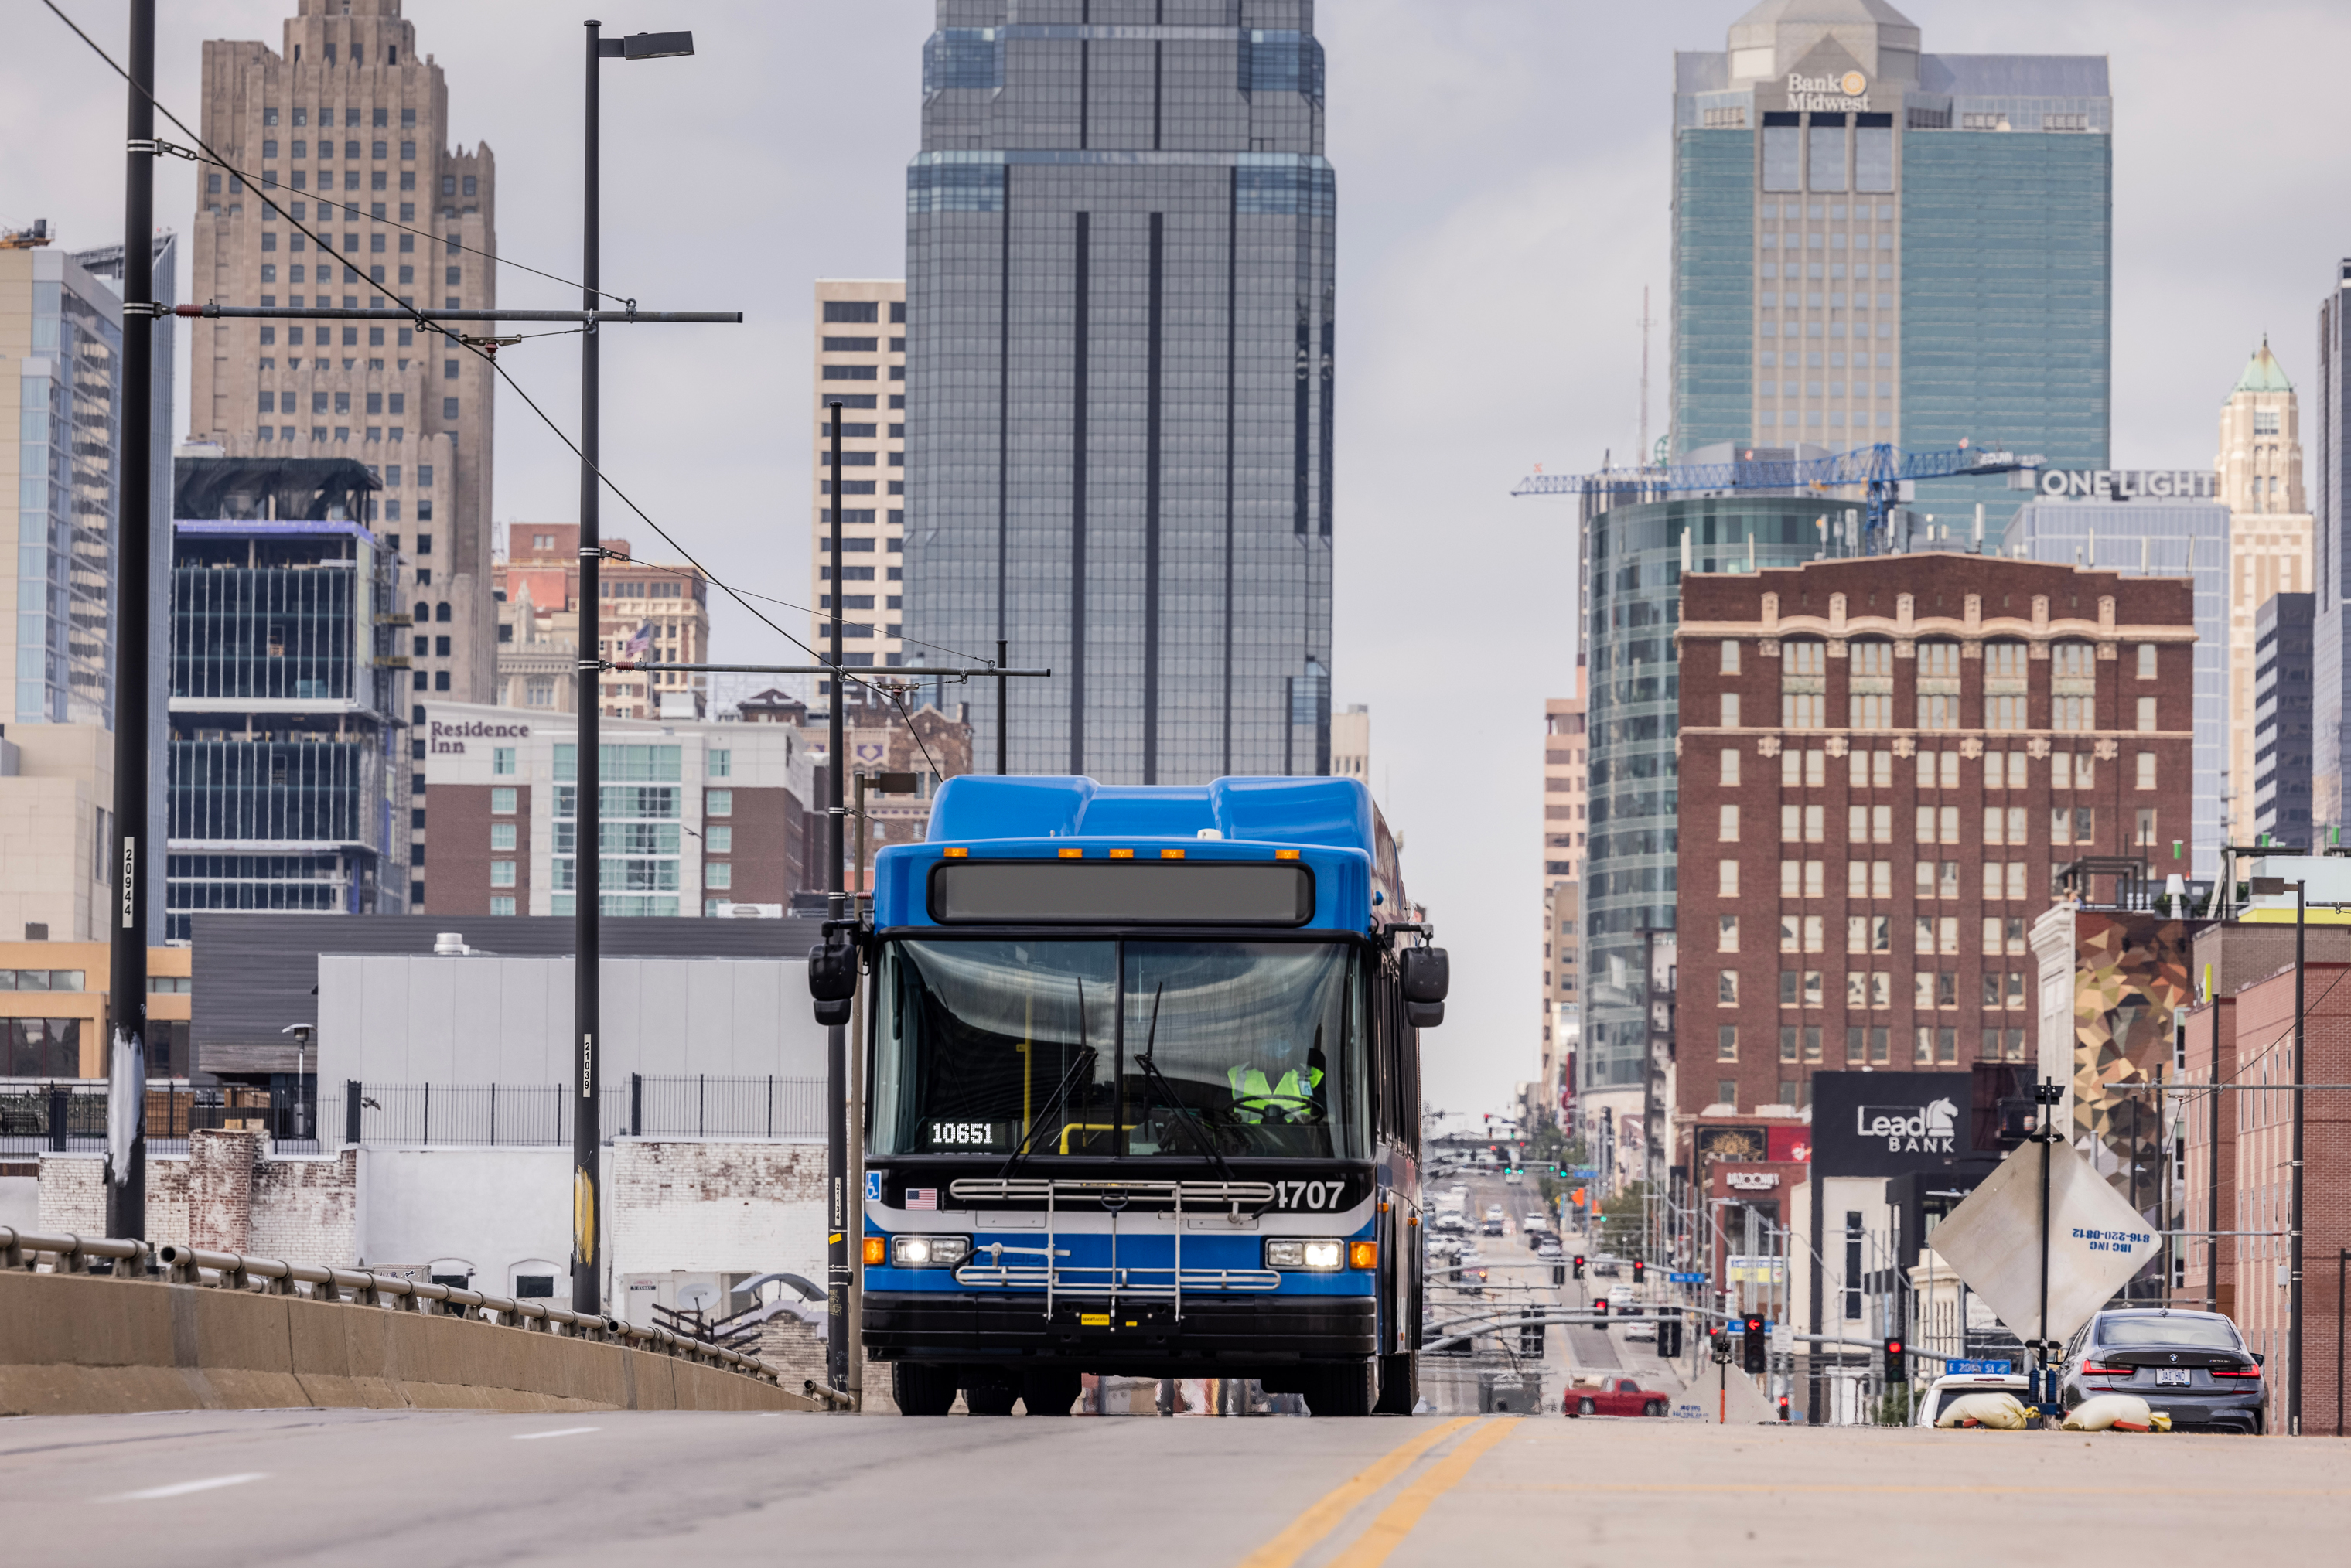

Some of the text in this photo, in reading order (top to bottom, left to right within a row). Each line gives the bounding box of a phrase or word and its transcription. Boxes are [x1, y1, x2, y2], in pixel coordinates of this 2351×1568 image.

[1787, 73, 1841, 92] Bank
[1787, 93, 1871, 112] Midwest
[2041, 469, 2216, 497] ONE LIGHT
[431, 721, 529, 737] Residence
[431, 738, 465, 753] Inn
[124, 849, 132, 915] 20944
[1858, 1105, 1926, 1137] Lead
[933, 1123, 993, 1144] 10651
[1889, 1137, 1955, 1153] BANK
[1275, 1181, 1345, 1209] 4707
[2073, 1228, 2150, 1243] 816-220-0812
[2090, 1241, 2131, 1253] IBC INC
[1949, 1363, 1995, 1373] E 20 St
[2161, 1372, 2172, 1381] JAI
